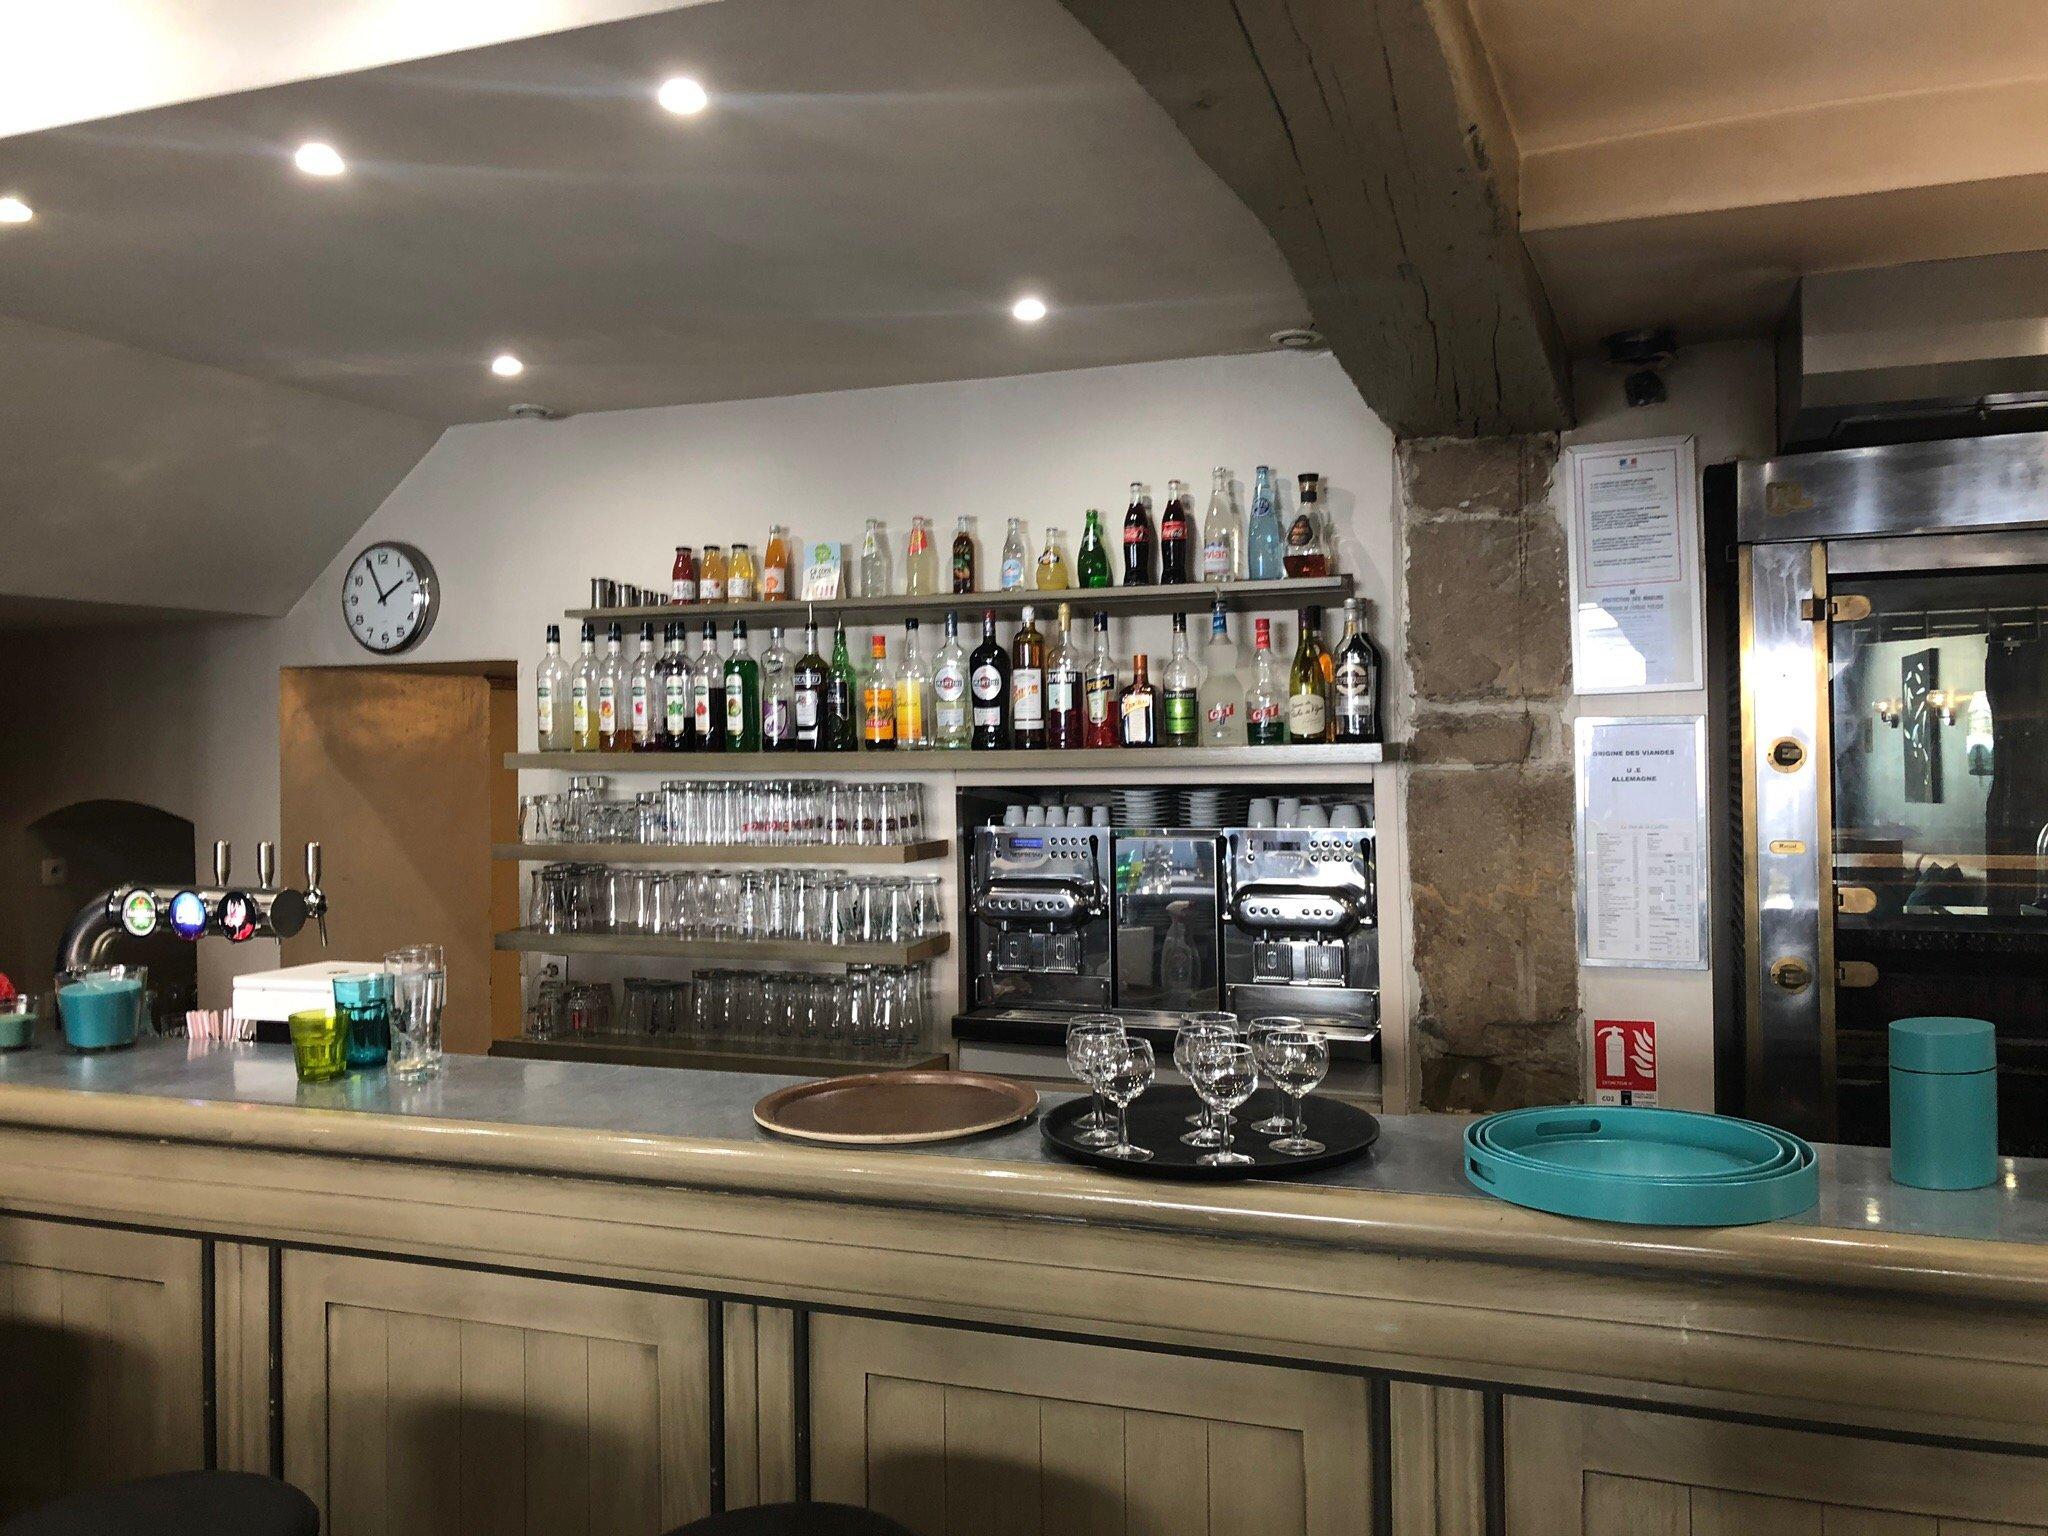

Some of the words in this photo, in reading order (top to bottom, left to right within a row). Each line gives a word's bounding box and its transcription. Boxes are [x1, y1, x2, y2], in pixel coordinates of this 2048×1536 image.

[377, 553, 389, 565] 12
[355, 576, 363, 587] 10
[406, 571, 414, 582] 2
[351, 595, 359, 606] 9
[356, 614, 364, 625] 8
[407, 611, 415, 621] 4
[366, 627, 374, 639] 7
[381, 632, 390, 643] 6
[396, 627, 405, 637] 5
